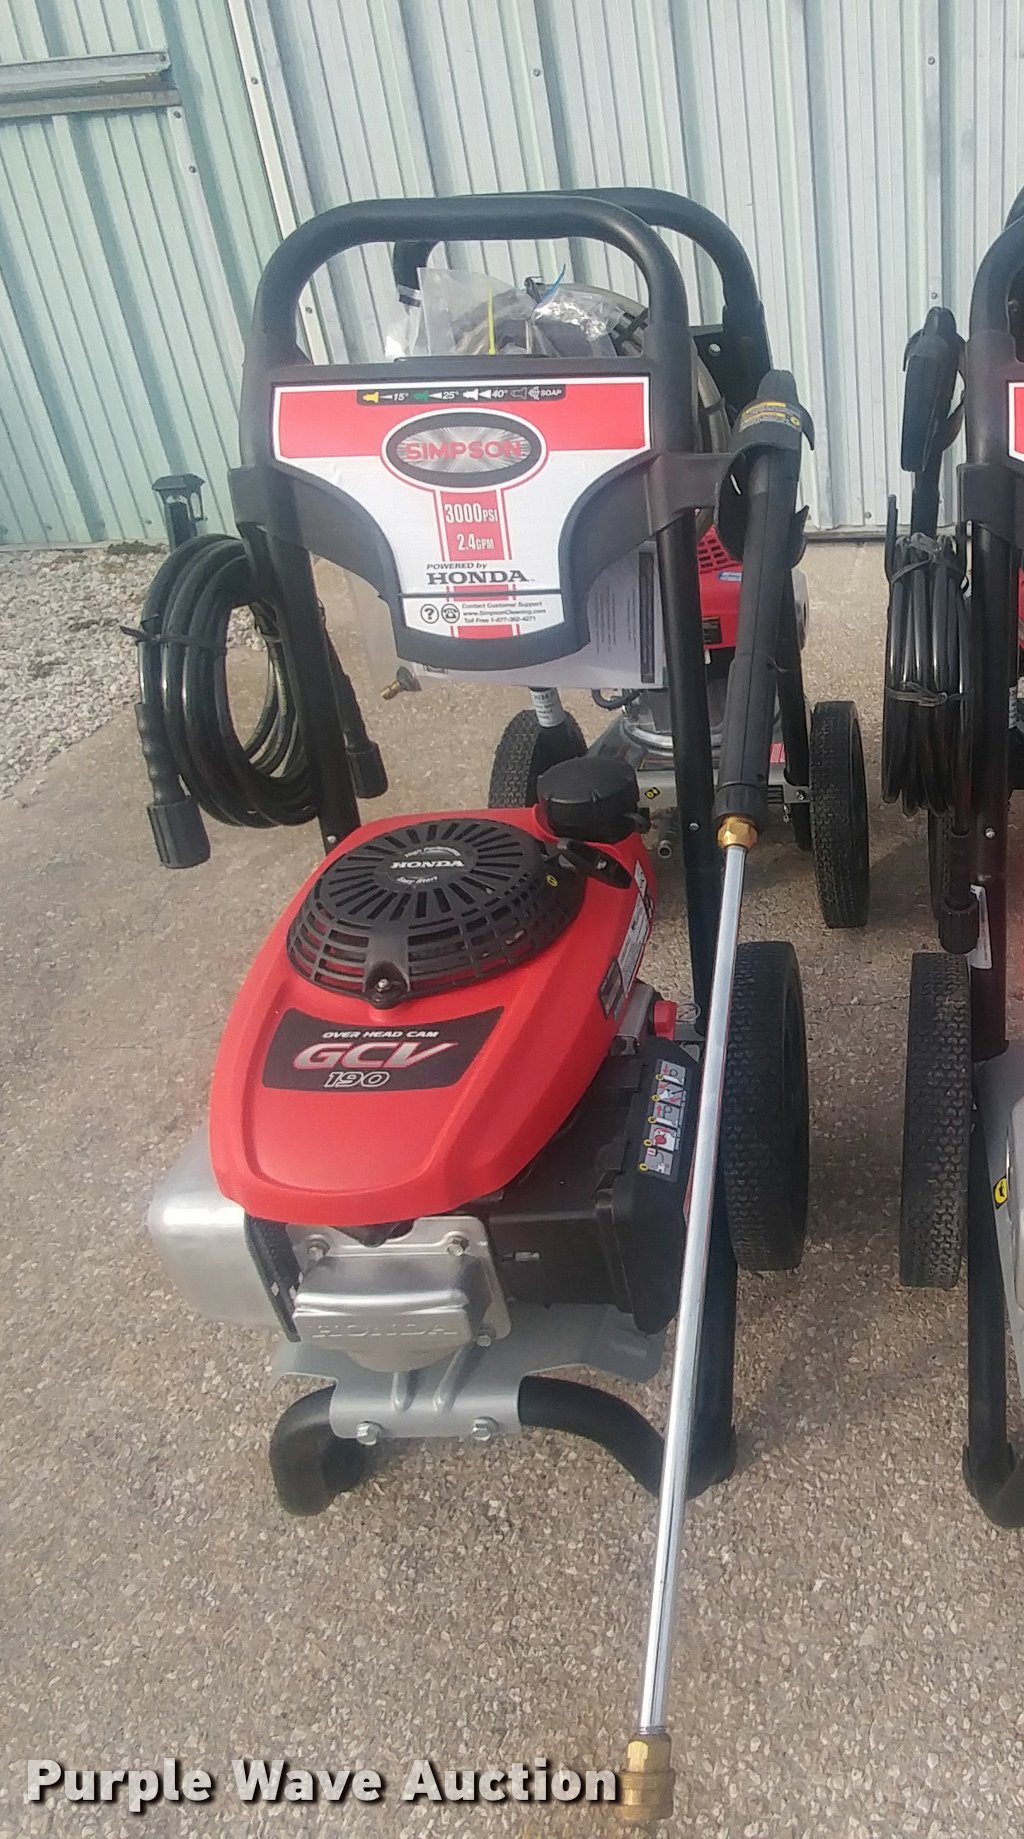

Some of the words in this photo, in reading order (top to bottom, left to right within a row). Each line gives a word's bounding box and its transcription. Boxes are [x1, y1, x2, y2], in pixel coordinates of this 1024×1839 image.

[540, 388, 562, 397] SOAP
[403, 440, 522, 461] SIMPSON
[444, 502, 498, 523] 3000PSI
[456, 533, 494, 551] 2.4GPM
[426, 562, 474, 570] POWERED
[476, 562, 487, 570] by
[426, 570, 530, 585] HONDA
[390, 860, 465, 869] HONDA
[322, 1031, 361, 1039] OVER
[362, 1030, 403, 1039] HEAD
[406, 1030, 440, 1038] CAM
[292, 1041, 459, 1069] GCV
[323, 1071, 390, 1088] 190
